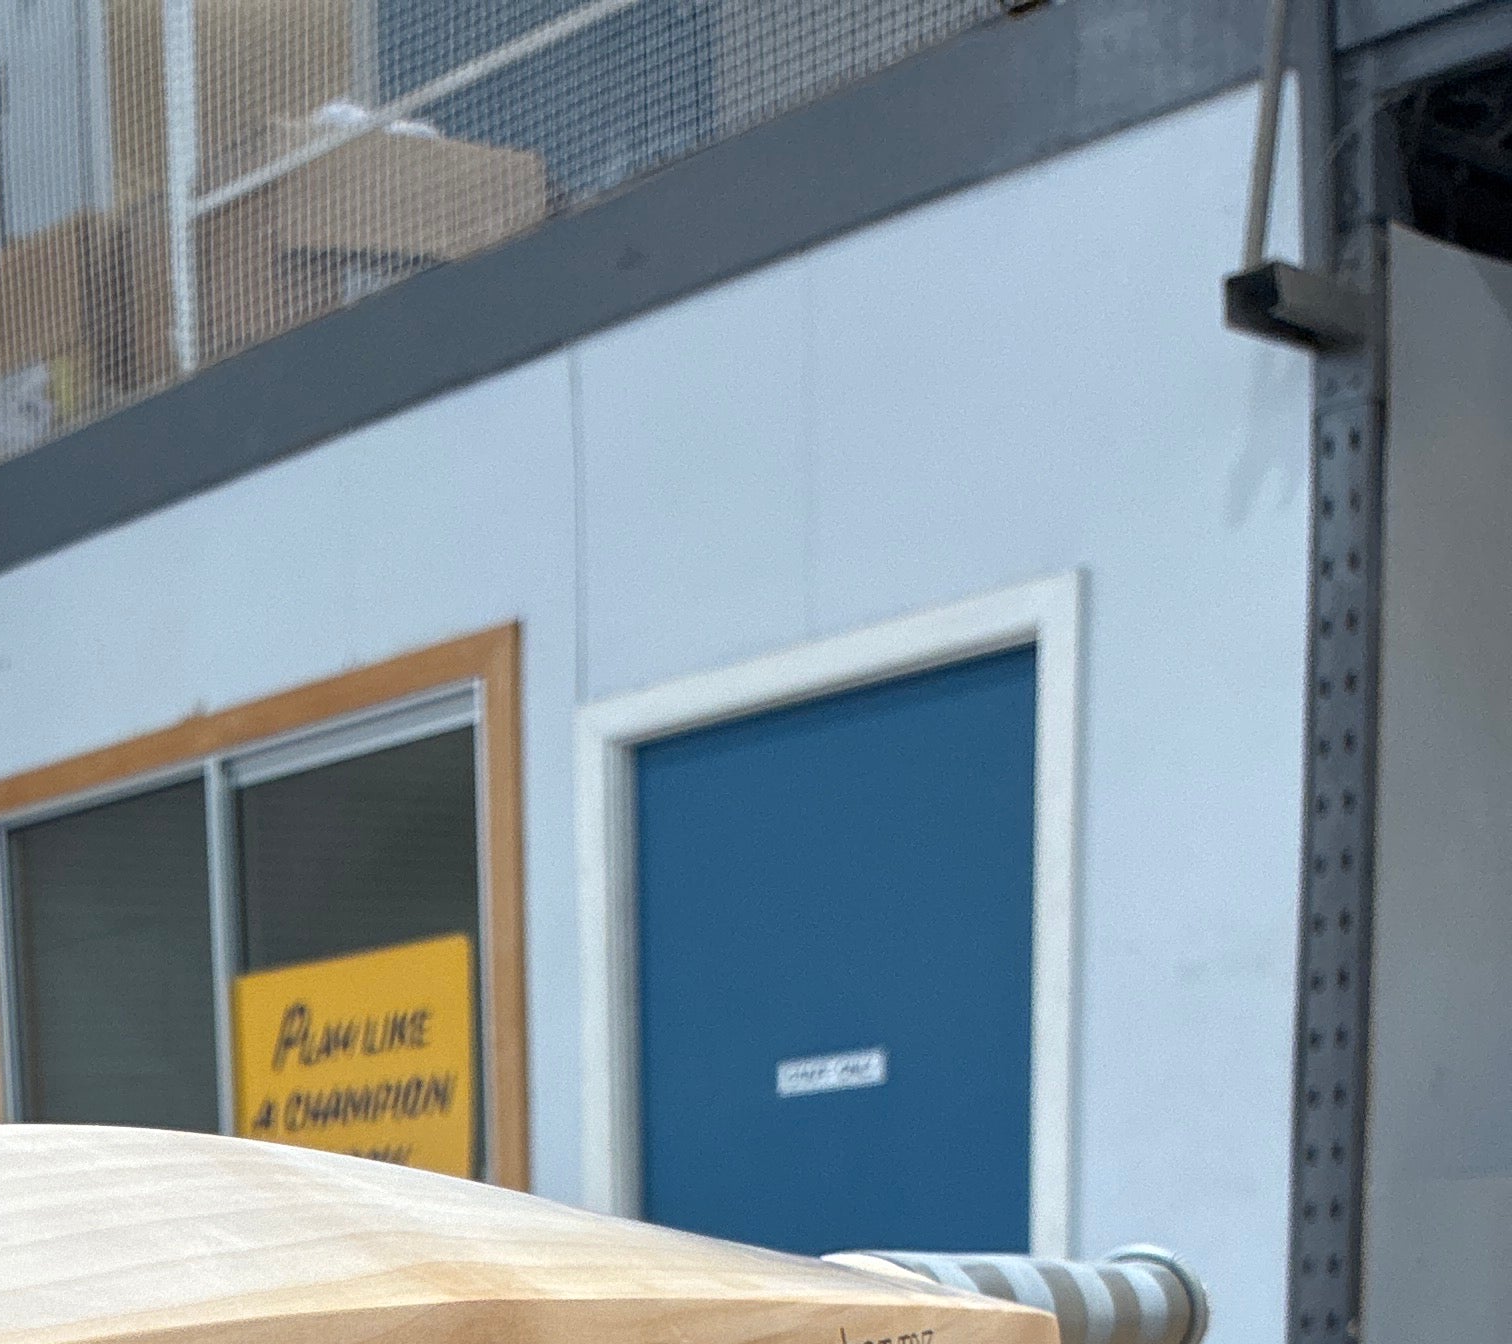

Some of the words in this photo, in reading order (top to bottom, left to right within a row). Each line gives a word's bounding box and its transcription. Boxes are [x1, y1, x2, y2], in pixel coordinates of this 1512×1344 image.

[360, 1006, 431, 1056] LIKE
[252, 1096, 278, 1132] A
[283, 1073, 456, 1131] CHAMPION
